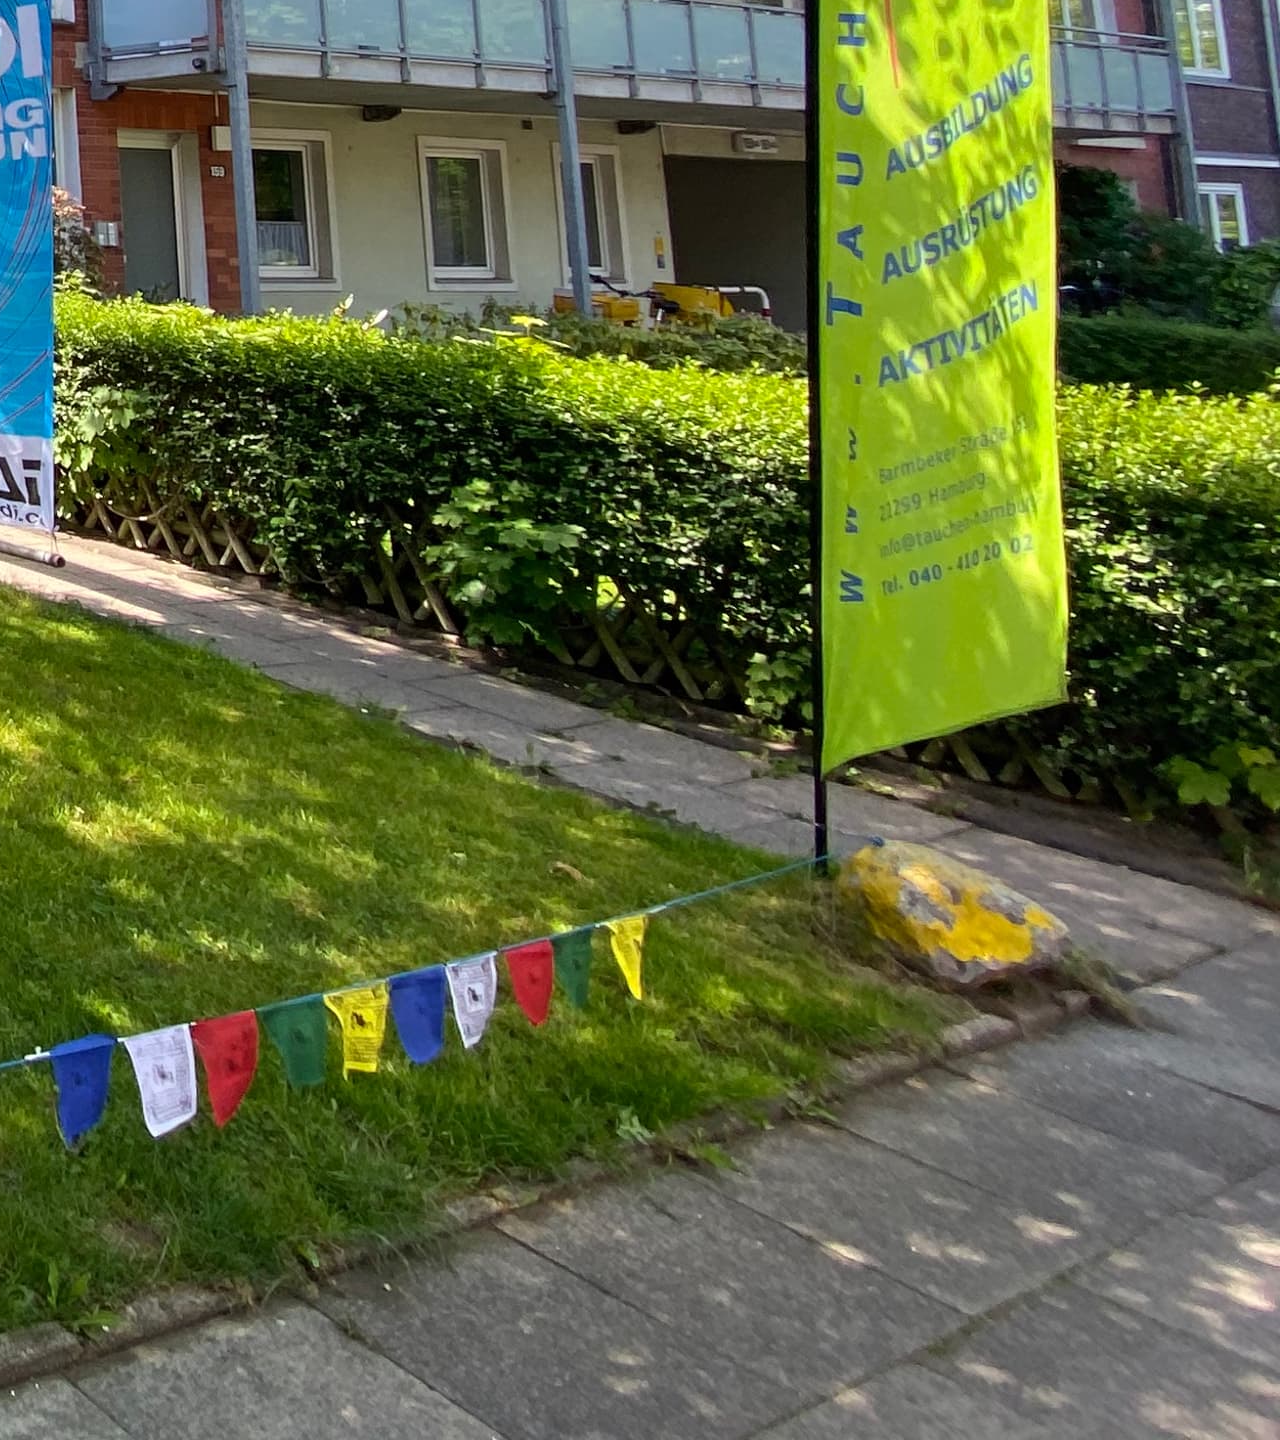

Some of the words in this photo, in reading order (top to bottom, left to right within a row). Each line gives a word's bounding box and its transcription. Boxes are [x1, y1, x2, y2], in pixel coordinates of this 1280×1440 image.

[885, 53, 1033, 181] AUSBILDUNG
[881, 165, 1039, 285] AUSRÜSTUNG
[878, 280, 1040, 387] AKTIVITÄTEN
[909, 563, 943, 586] 040
